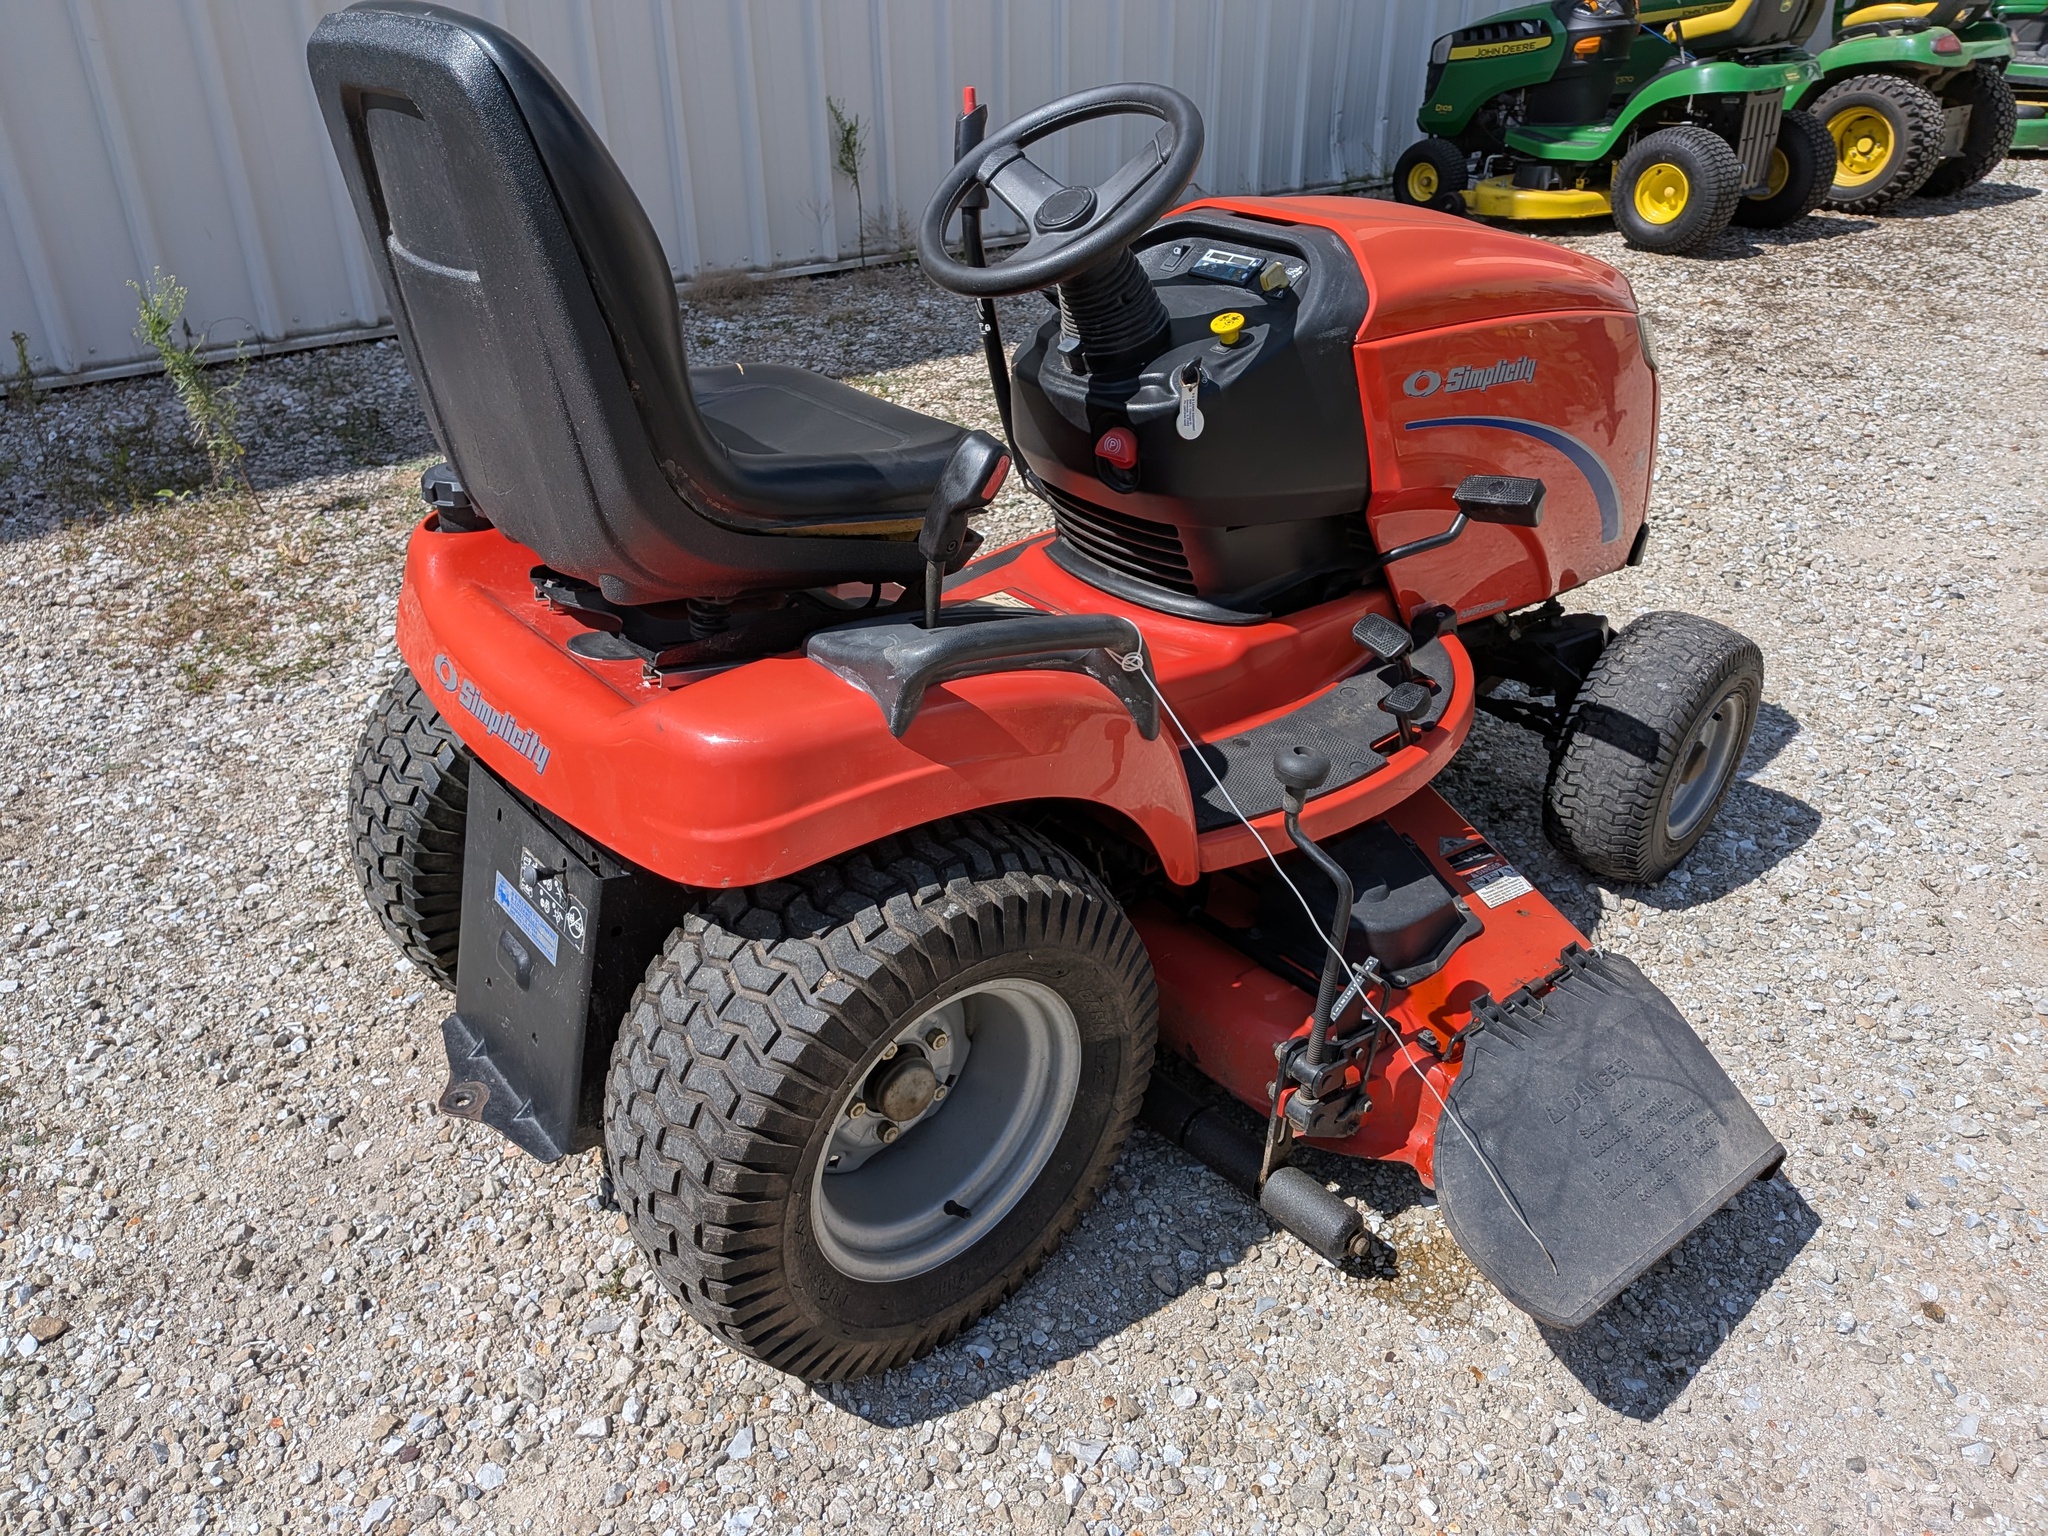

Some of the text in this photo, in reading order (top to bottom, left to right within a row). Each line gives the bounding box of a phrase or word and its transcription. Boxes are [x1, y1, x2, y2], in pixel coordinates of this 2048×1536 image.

[1475, 42, 1536, 57] JOHN DEERE
[1445, 356, 1538, 394] Simplicity
[459, 680, 551, 775] Simplicity
[1478, 862, 1502, 877] DANGER
[1565, 1058, 1636, 1112] DANGER
[1593, 1167, 1611, 1183] Do
